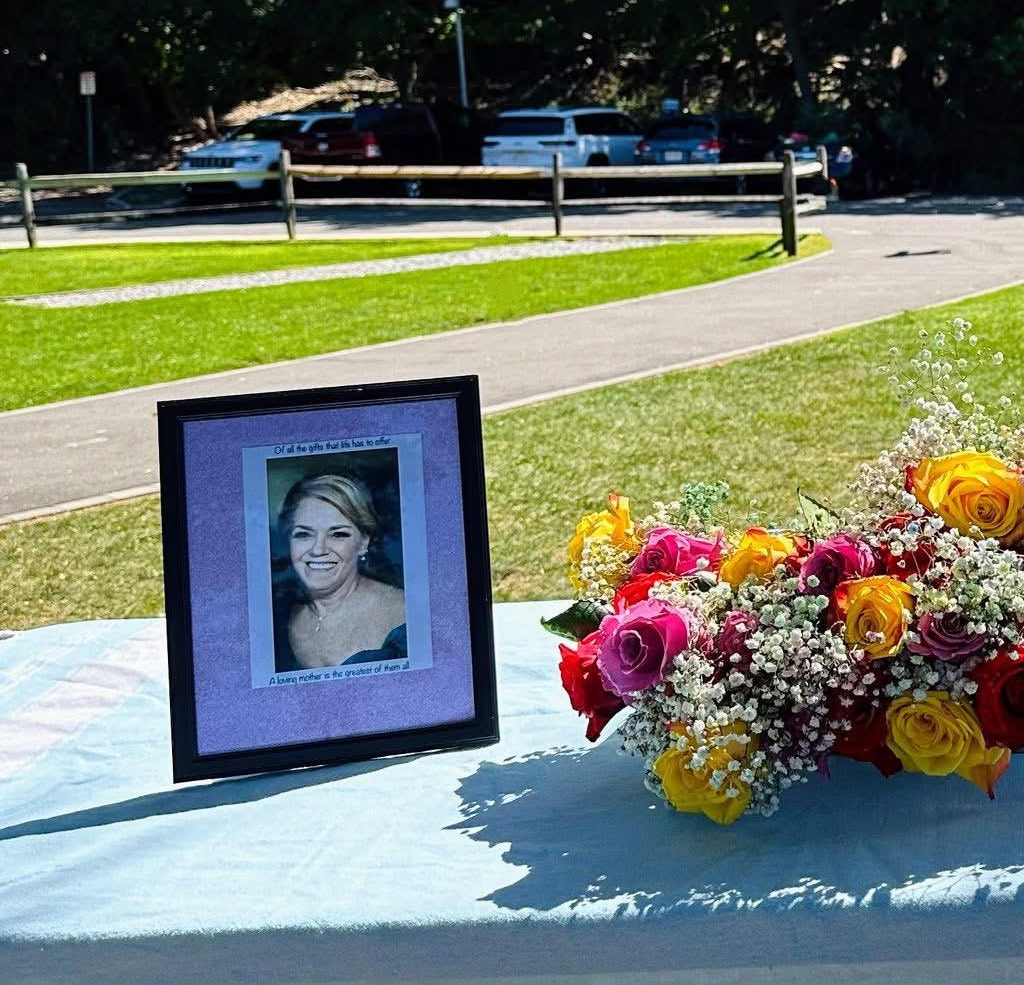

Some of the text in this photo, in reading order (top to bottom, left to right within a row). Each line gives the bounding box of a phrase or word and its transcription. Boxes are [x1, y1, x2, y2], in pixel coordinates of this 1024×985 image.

[274, 446, 284, 454] Of
[287, 445, 295, 454] all
[308, 443, 324, 454] gifts
[375, 437, 392, 446] offer
[269, 677, 276, 686] A
[277, 675, 298, 684] loving
[299, 673, 322, 682] mother
[344, 667, 372, 678] greatest
[374, 665, 382, 673] of
[384, 664, 400, 672] them
[402, 661, 410, 670] all
